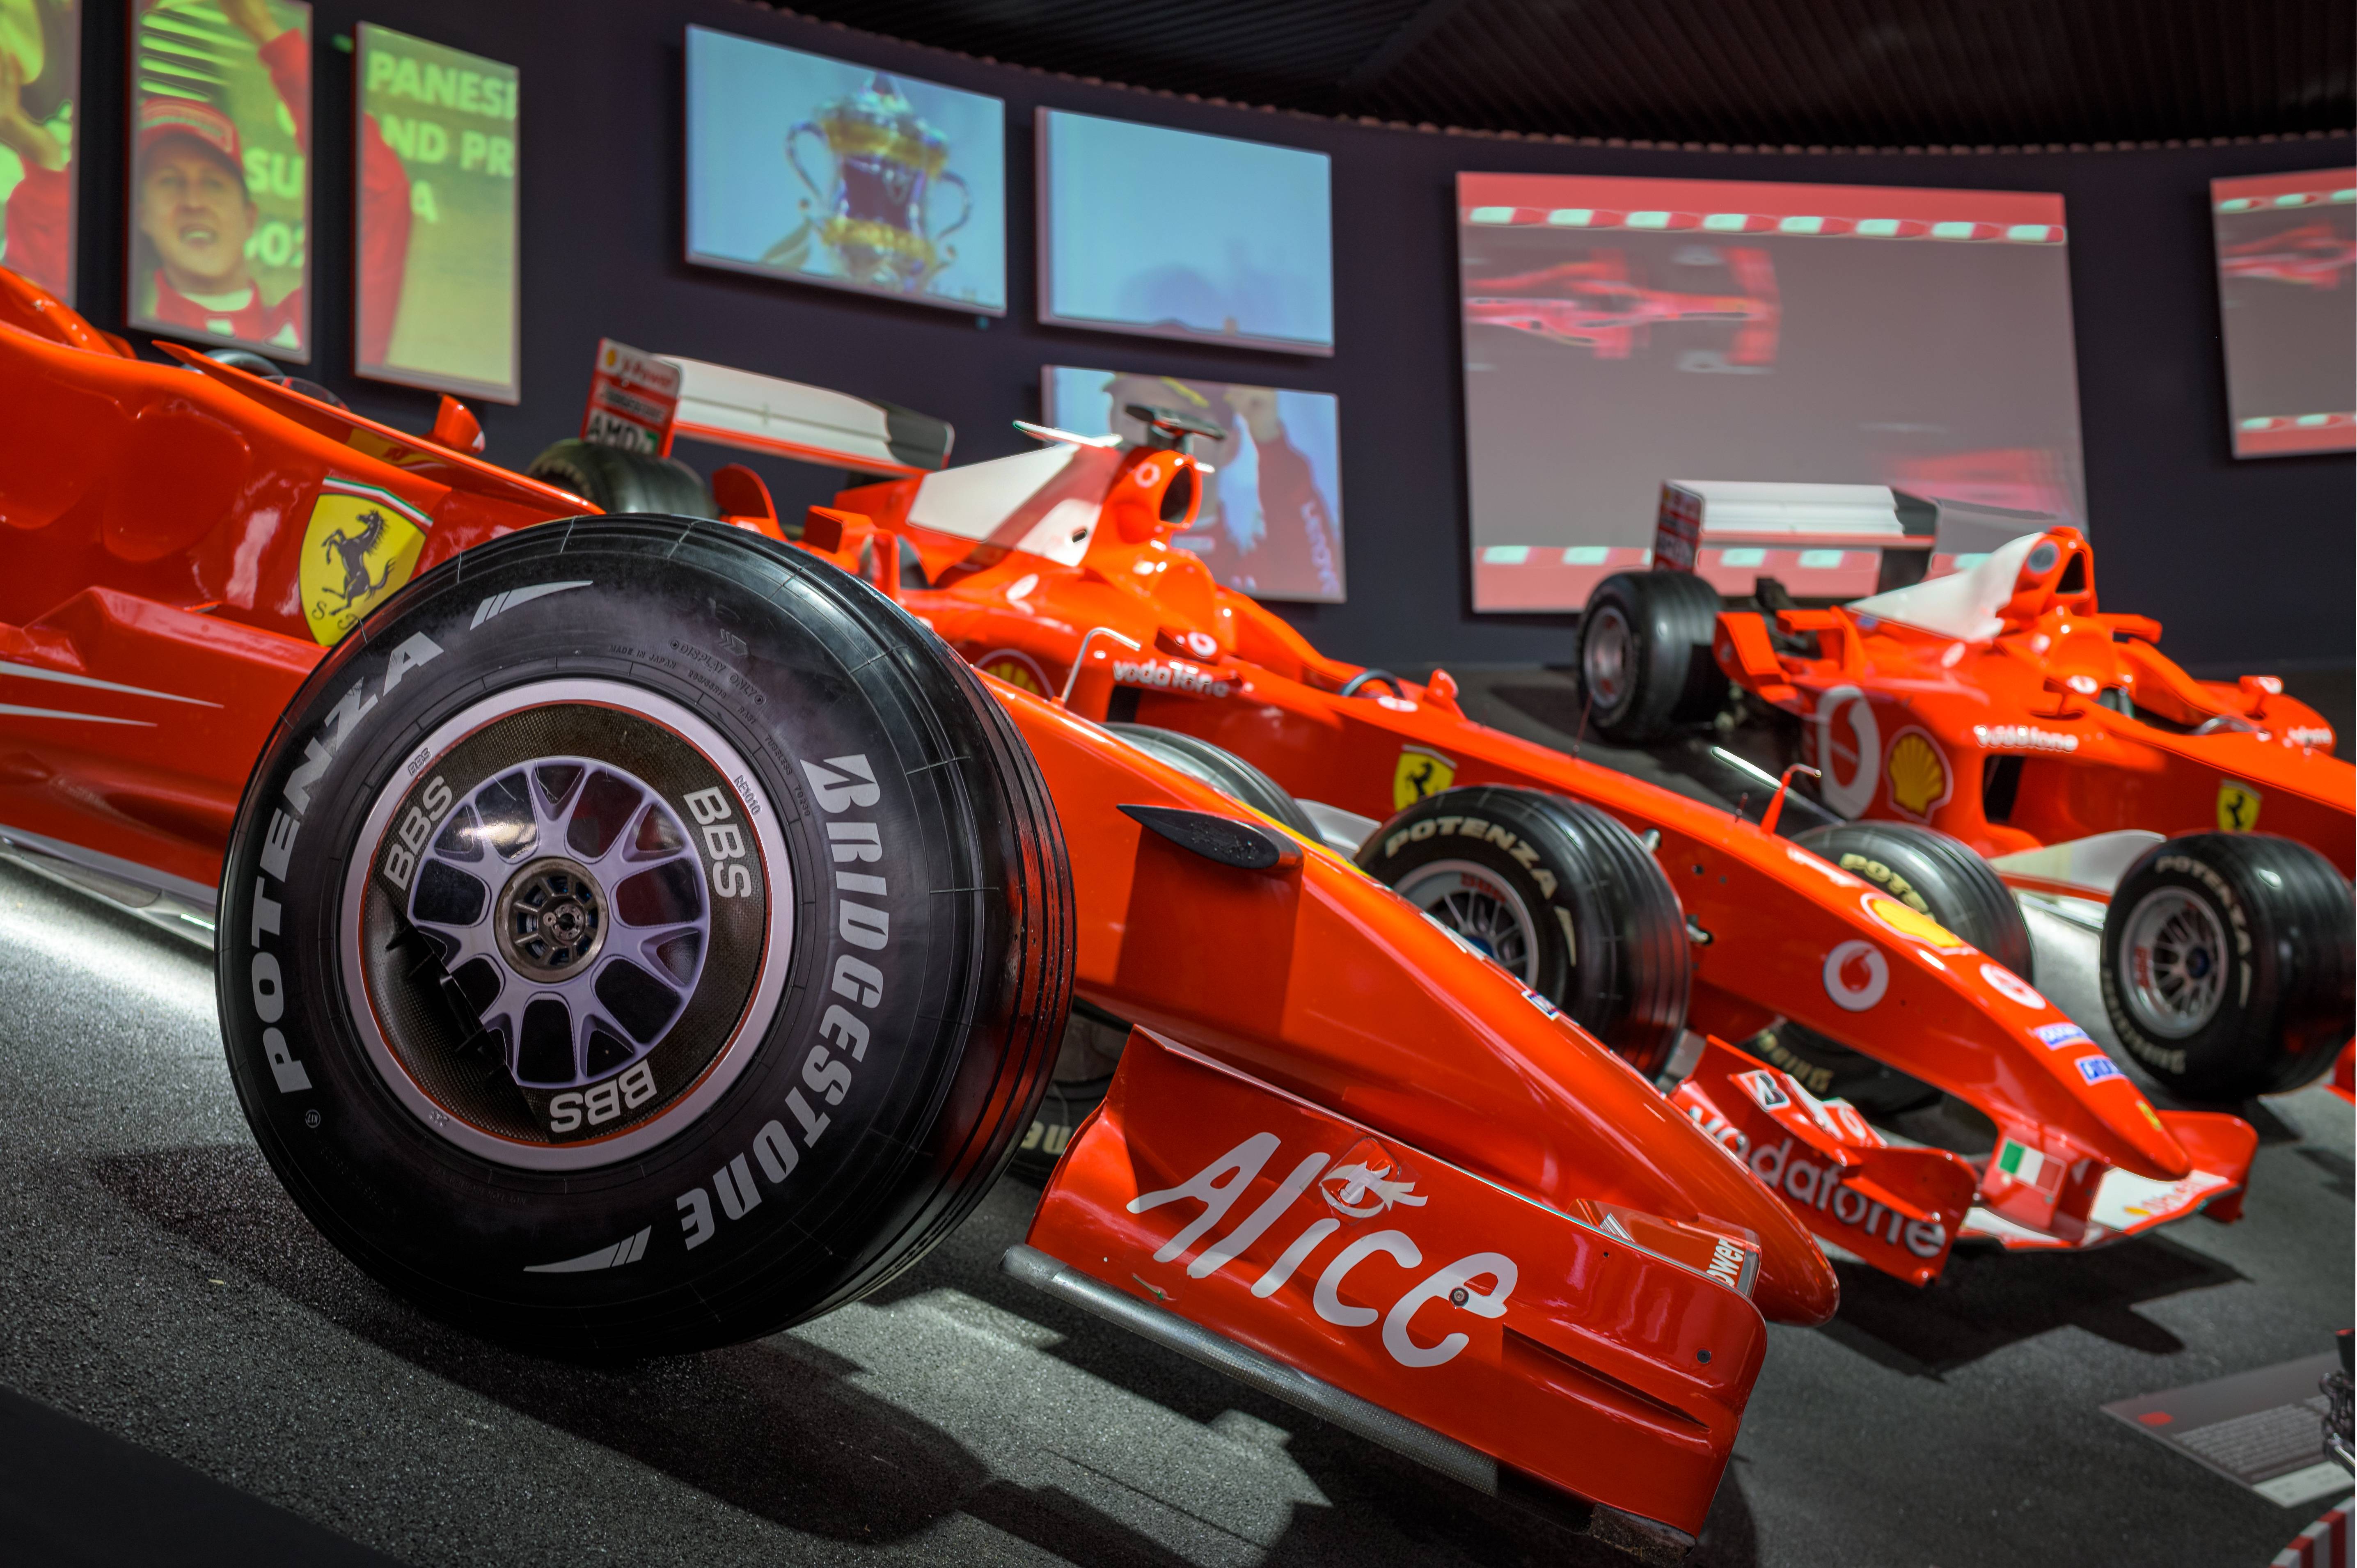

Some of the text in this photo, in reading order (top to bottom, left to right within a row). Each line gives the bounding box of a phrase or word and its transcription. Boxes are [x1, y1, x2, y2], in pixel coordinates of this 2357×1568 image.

[312, 600, 327, 621] S
[636, 650, 647, 658] IN
[648, 652, 676, 669] JAPAN
[678, 643, 757, 699] DISPLAY ONLY
[407, 748, 432, 776] BBS
[252, 631, 444, 1093] POTENZA
[384, 776, 453, 890] BBS
[683, 786, 752, 899] BBS
[1385, 816, 1558, 900] POTENZA
[676, 754, 889, 1250] BRIDGESTONE
[550, 1059, 657, 1133] BBS
[1126, 1132, 1518, 1368] Alice
